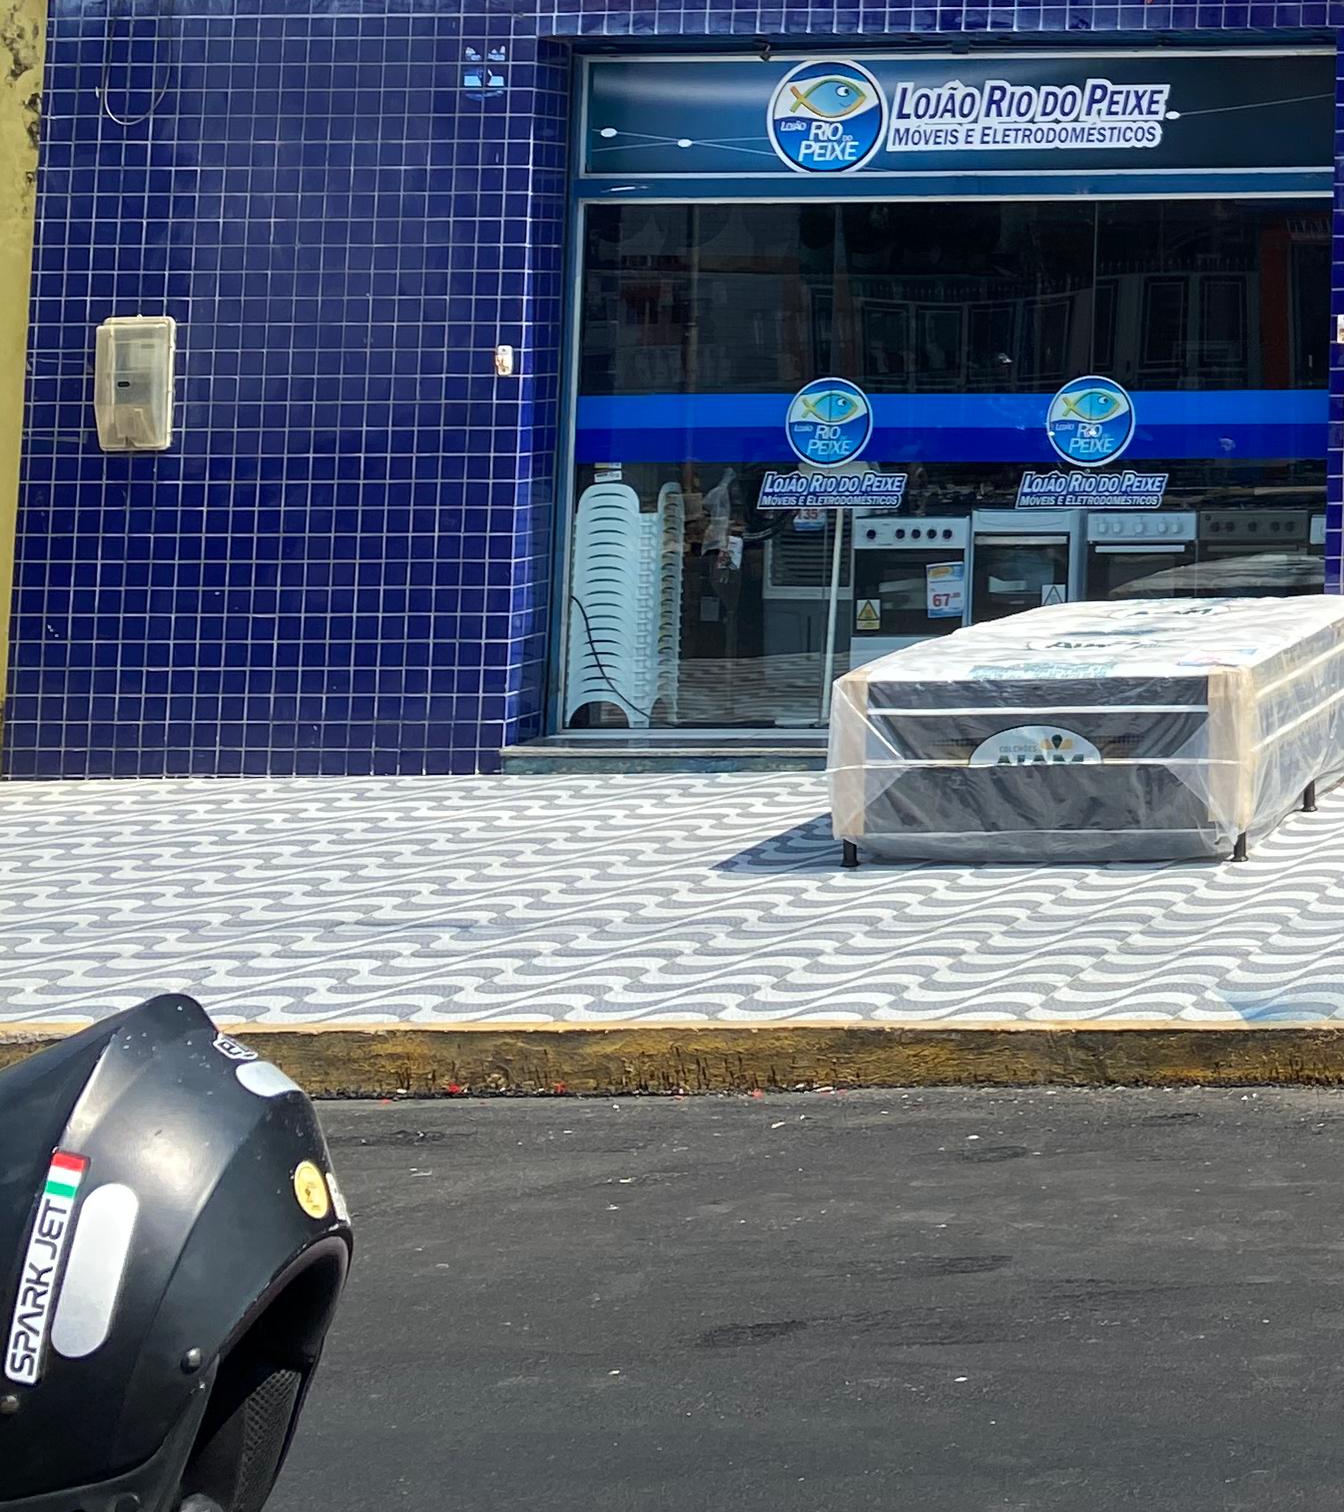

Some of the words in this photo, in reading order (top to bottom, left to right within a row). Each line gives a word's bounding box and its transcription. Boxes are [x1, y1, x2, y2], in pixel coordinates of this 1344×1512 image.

[895, 86, 976, 120] LOJÃO
[984, 84, 1033, 119] RIO
[1040, 90, 1077, 118] DO
[1085, 83, 1164, 117] PEIXE
[808, 121, 844, 141] RIO
[892, 124, 960, 146] MÓVEIS
[964, 128, 974, 145] E
[980, 122, 1157, 145] ELETRODOMÉSTICOS
[798, 140, 860, 162] PEIXE
[815, 425, 841, 439] RIO
[1077, 423, 1102, 438] RIO
[807, 439, 853, 455] PEIXE
[1068, 438, 1115, 454] PEIXE
[764, 474, 807, 493] LOJÃO
[810, 473, 836, 493] RIO
[837, 476, 858, 492] DO
[861, 473, 903, 492] PEIXE
[1022, 474, 1067, 493] LOJÃO
[1068, 473, 1096, 492] RIO
[1097, 476, 1118, 492] DO
[1121, 473, 1164, 492] PEIXE
[931, 593, 951, 608] 67
[9, 1261, 54, 1376] SPARK
[34, 1198, 68, 1261] JET
